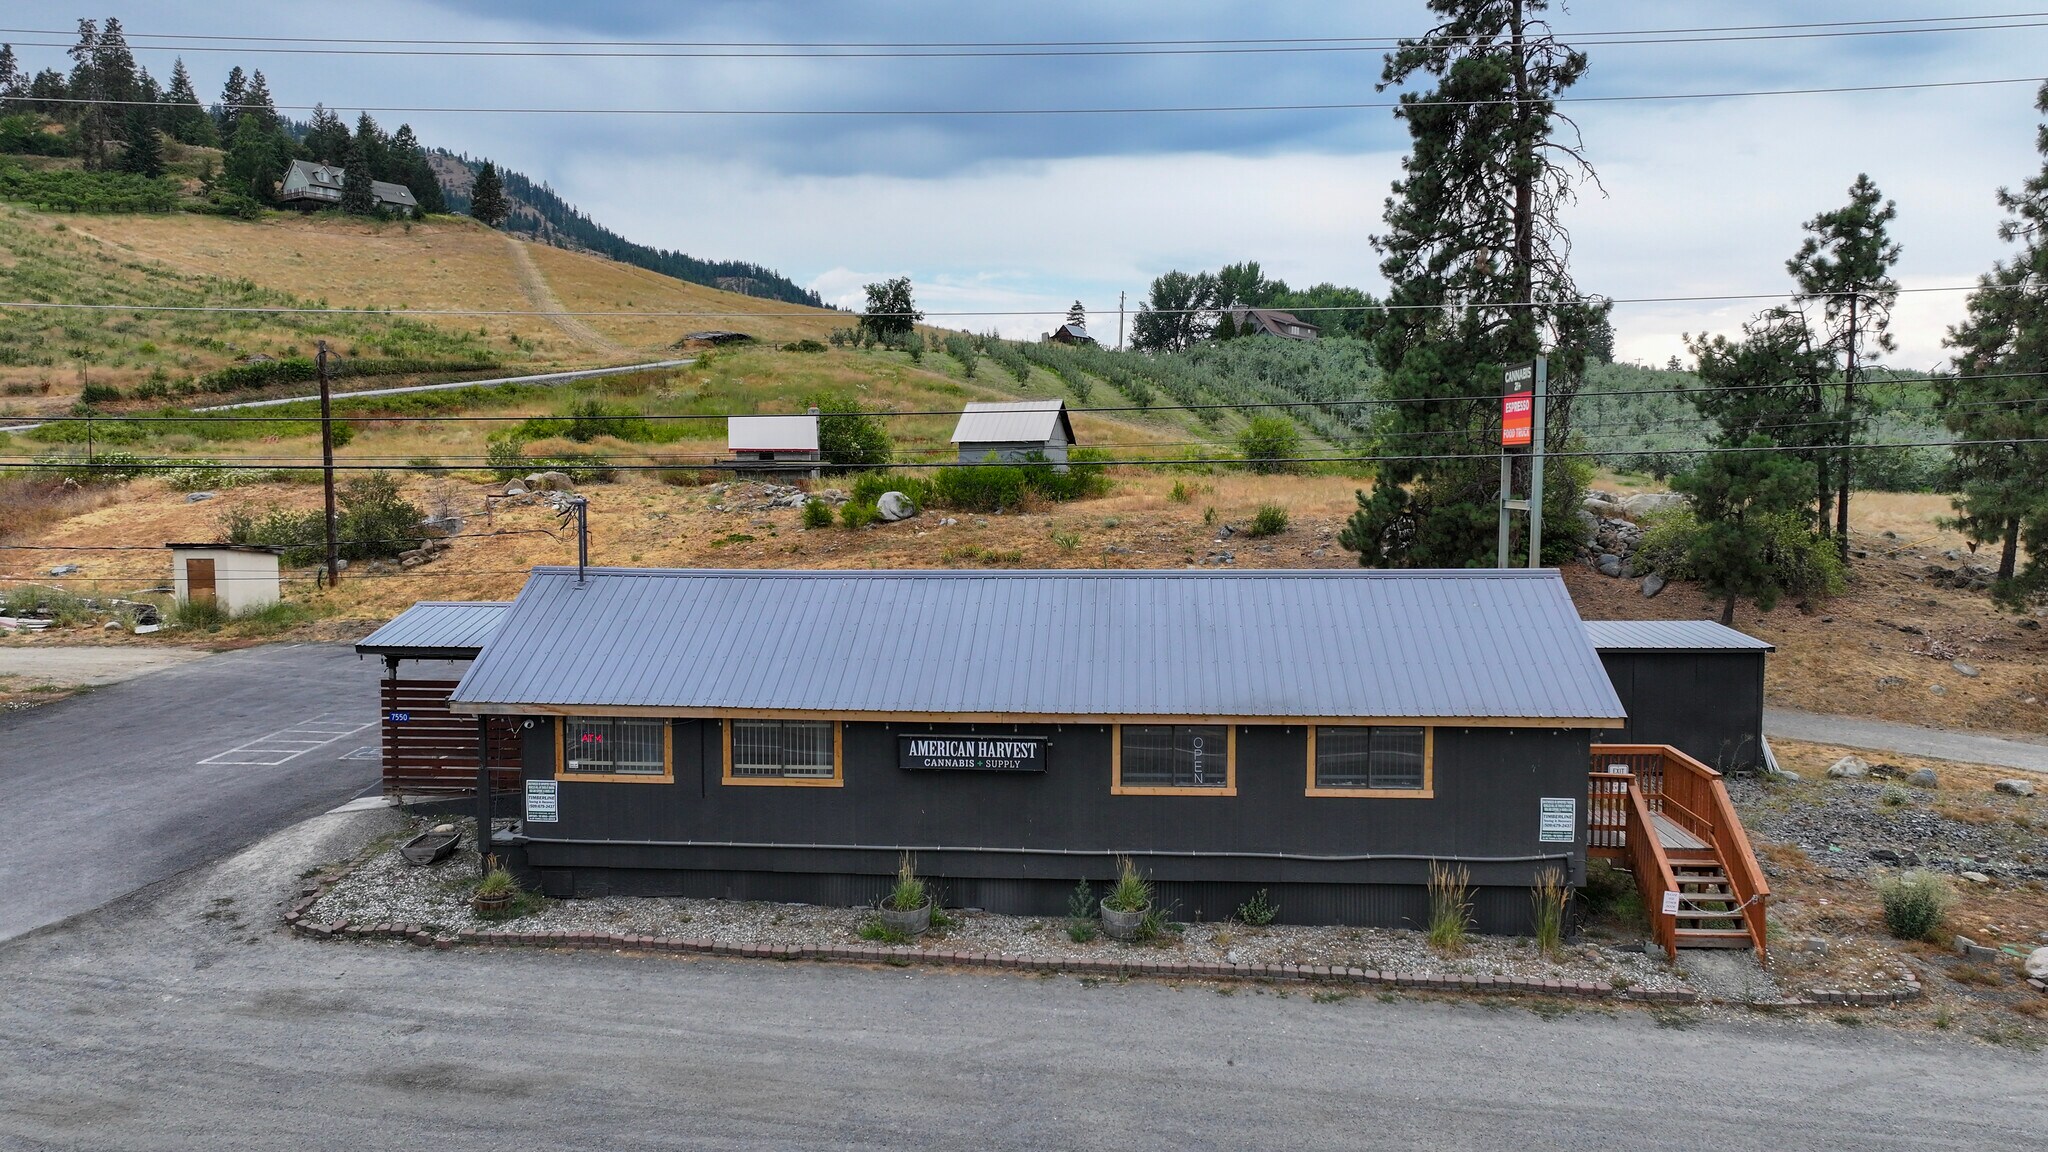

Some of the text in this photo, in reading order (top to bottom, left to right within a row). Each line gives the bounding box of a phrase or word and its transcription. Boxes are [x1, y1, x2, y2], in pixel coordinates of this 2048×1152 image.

[1505, 367, 1531, 383] CANNABIS
[1505, 400, 1530, 413] ESPRESSO
[1503, 427, 1530, 438] FOOD TRUCK
[391, 713, 408, 721] 7550
[908, 740, 1037, 759] AMERICAN HARVEST
[924, 758, 975, 768] CANNABIS
[985, 760, 1021, 769] SUPPLY
[1193, 737, 1204, 784] OPEN
